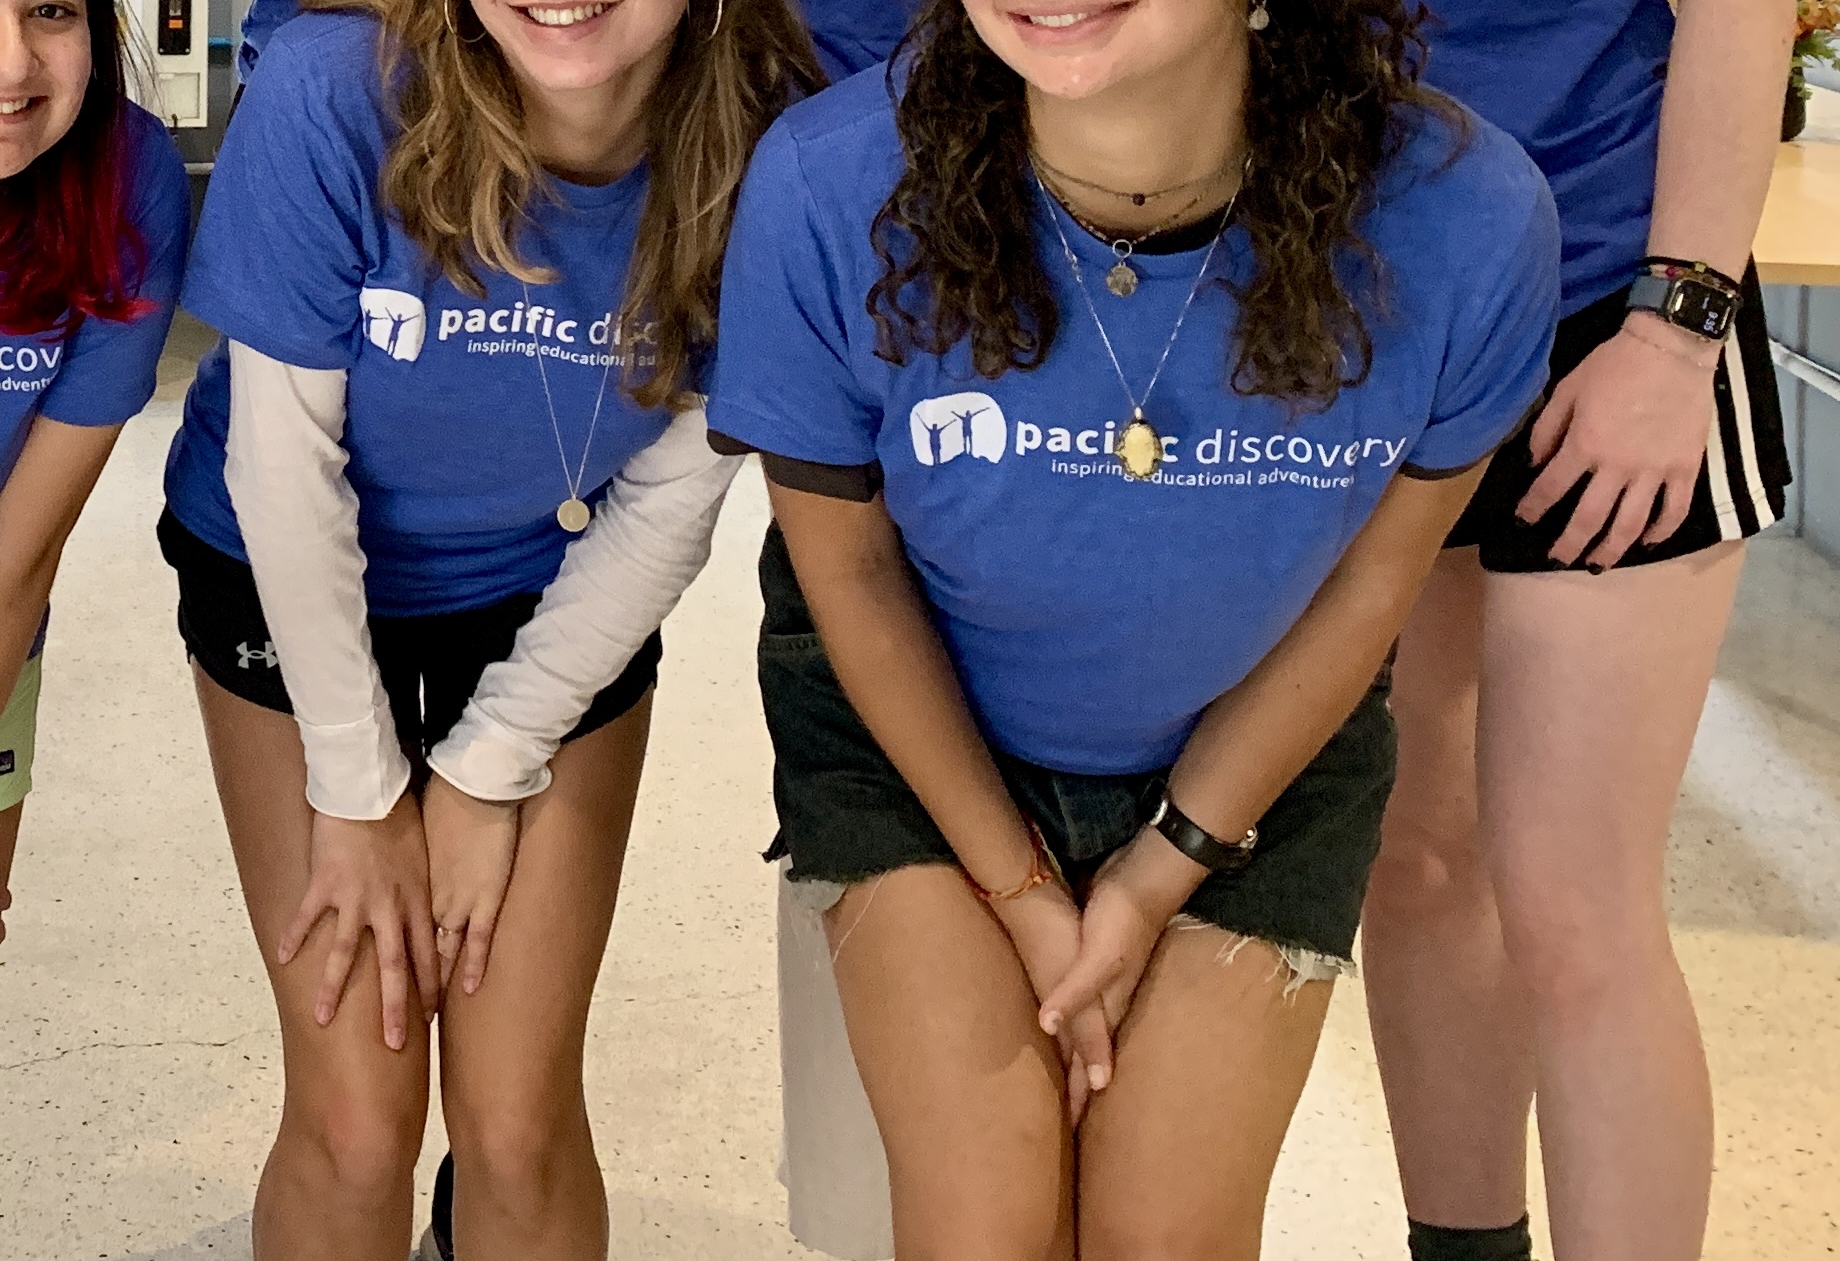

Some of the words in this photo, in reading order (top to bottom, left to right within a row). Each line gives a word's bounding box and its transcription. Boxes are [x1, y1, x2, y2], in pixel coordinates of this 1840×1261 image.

[438, 301, 578, 344] pacific
[467, 339, 536, 357] inspiring
[1016, 420, 1179, 463] pacic
[1196, 428, 1407, 468] discovery
[1143, 468, 1252, 487] ducational
